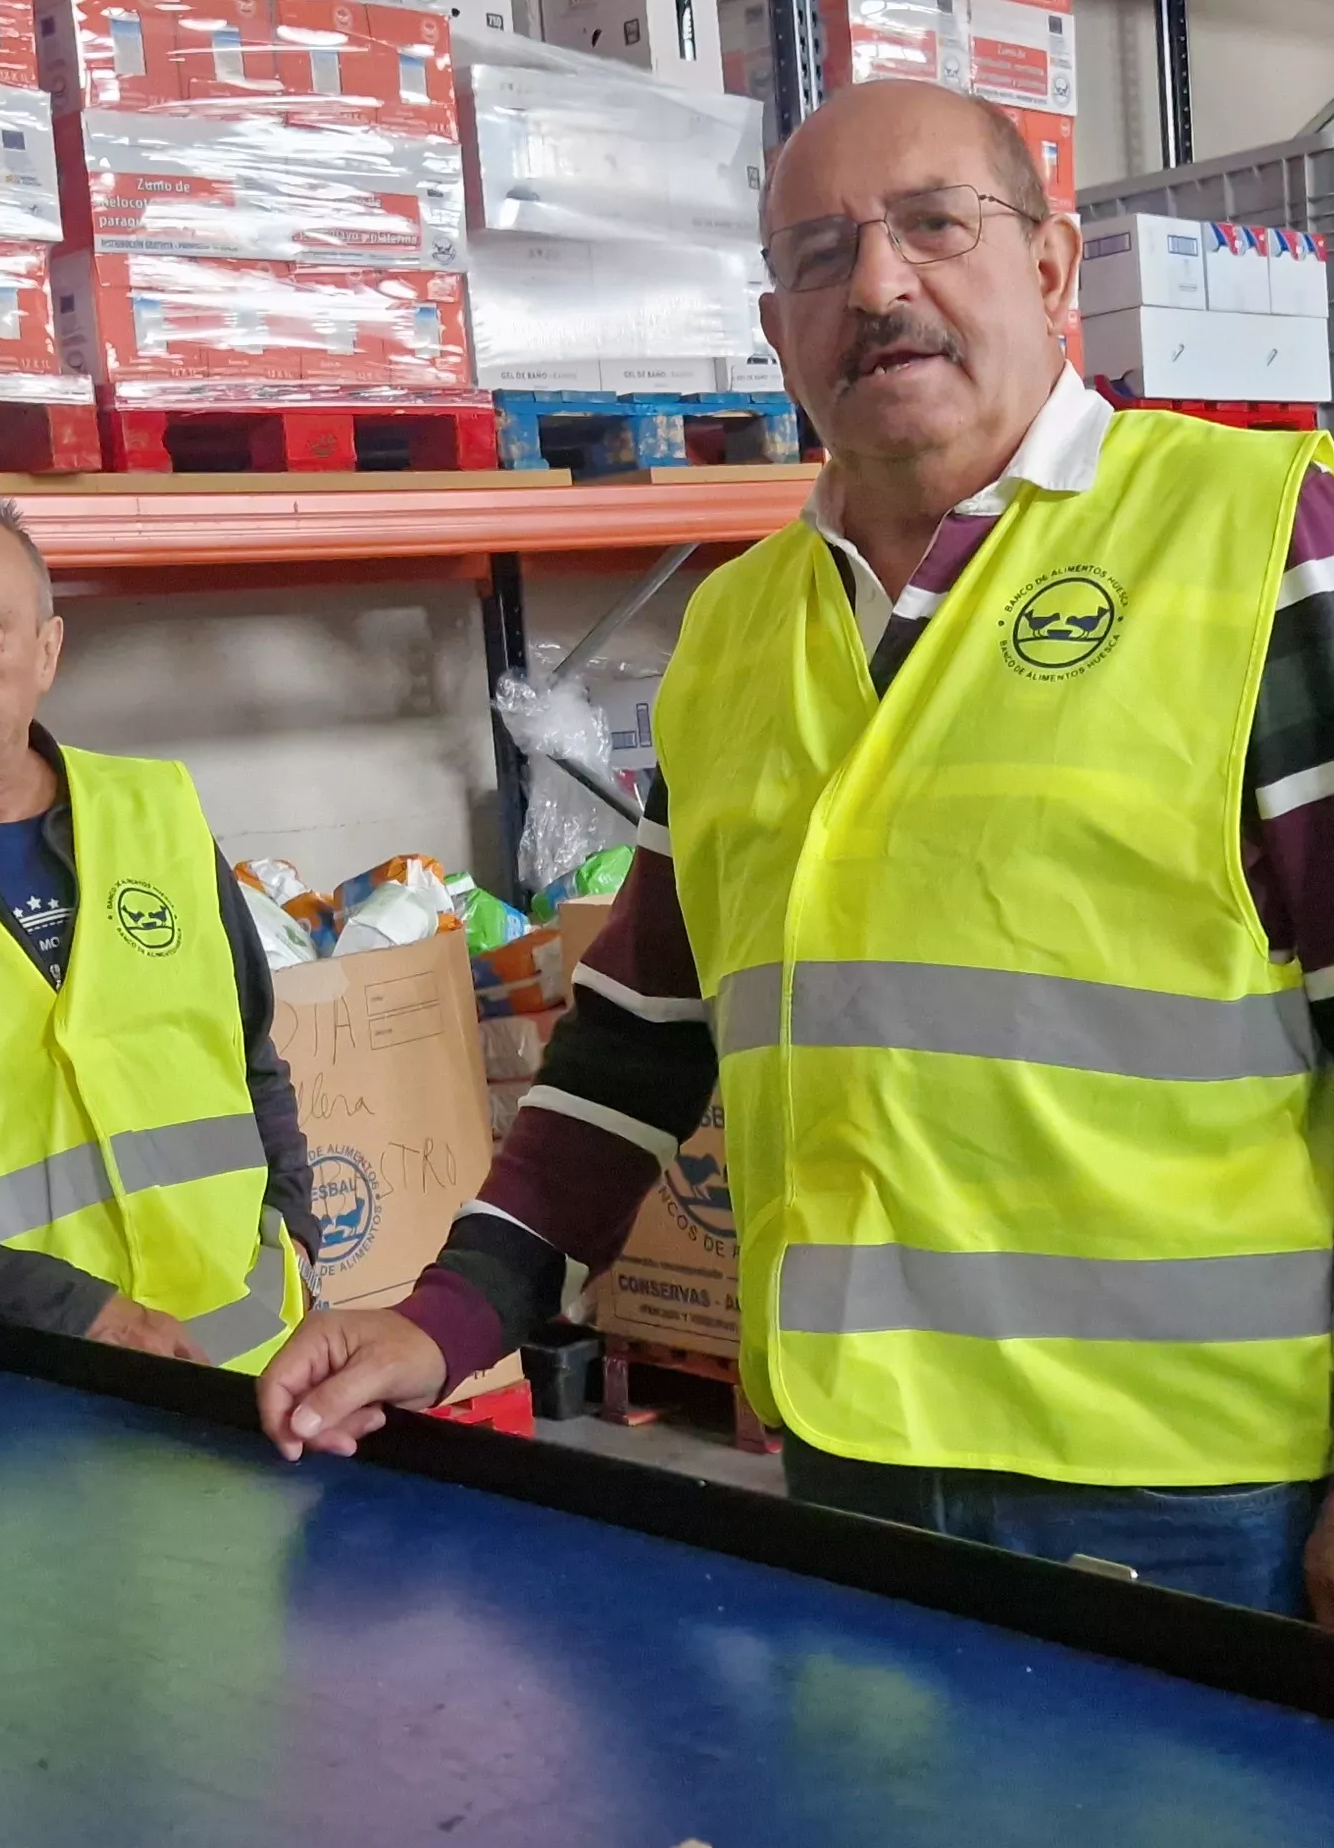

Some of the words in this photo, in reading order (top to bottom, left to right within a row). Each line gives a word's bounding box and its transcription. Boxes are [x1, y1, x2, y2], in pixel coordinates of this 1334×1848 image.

[137, 178, 172, 193] Zumo
[175, 180, 191, 193] de
[500, 371, 514, 381] GEL
[516, 371, 526, 381] DE
[623, 370, 636, 379] GEL
[1004, 583, 1034, 613] BANCO
[1034, 574, 1048, 586] DE
[1051, 564, 1108, 579] ALIMENTOS
[999, 639, 1015, 668] BANCO
[1014, 664, 1026, 676] DE
[1026, 667, 1085, 683] ALIMENTOS
[1087, 633, 1120, 669] HUESCA
[308, 1145, 324, 1162] DE
[327, 1143, 380, 1190] ALIMENTOS
[310, 1177, 358, 1202] ESBAL
[319, 1265, 336, 1277] DE
[340, 1205, 383, 1272] ALIMENTOS
[703, 1234, 726, 1258] DE
[618, 1273, 711, 1308] CONSERVAS
